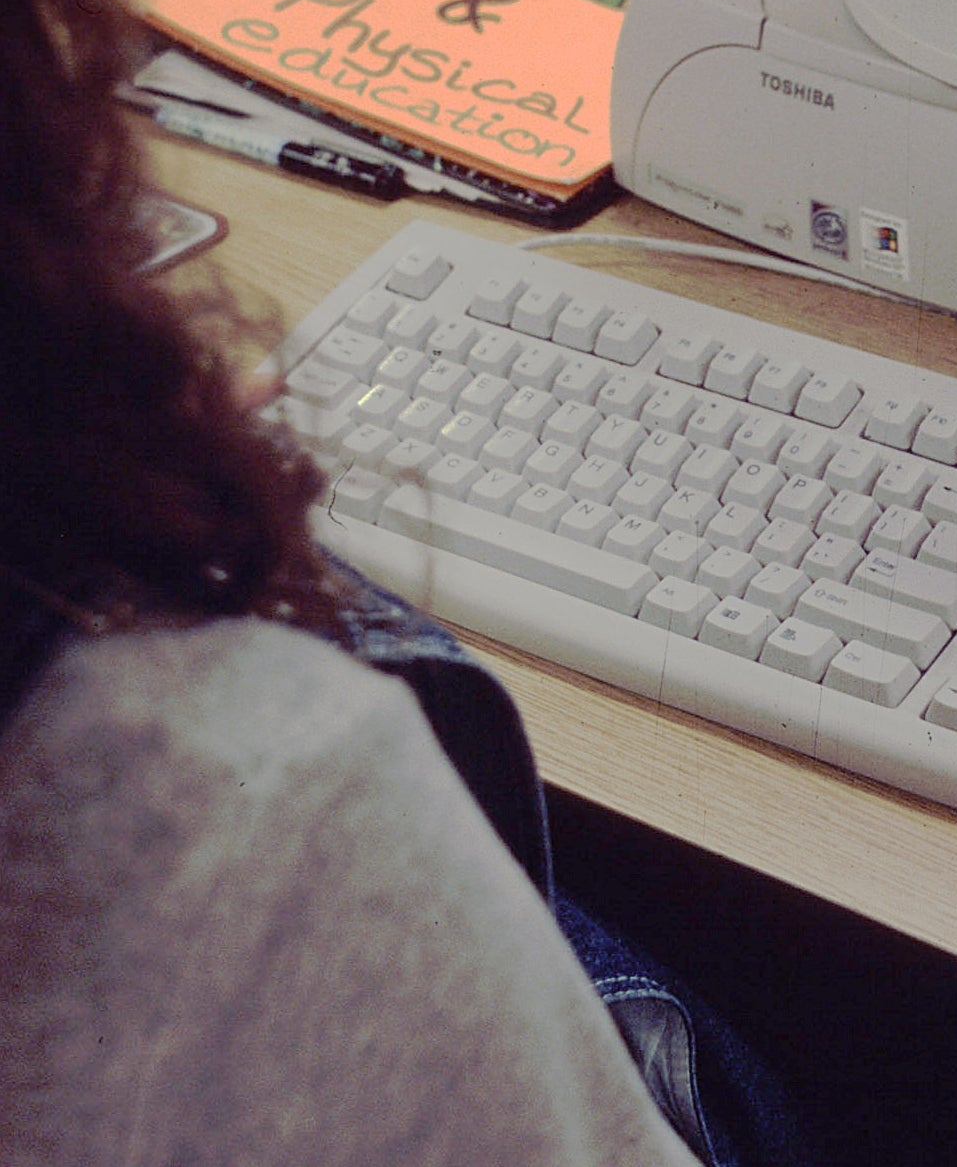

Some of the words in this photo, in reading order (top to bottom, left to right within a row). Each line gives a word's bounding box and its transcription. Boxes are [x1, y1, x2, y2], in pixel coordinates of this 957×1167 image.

[220, 17, 576, 168] education
[760, 71, 836, 111] TOSHIBA
[522, 390, 535, 402] R
[567, 405, 580, 416] T
[612, 419, 624, 431] Y
[653, 433, 668, 446] U
[402, 442, 418, 453] X
[545, 445, 560, 457] G
[447, 457, 460, 469] C
[588, 460, 605, 472] H
[746, 463, 761, 476] O
[634, 478, 649, 488] J
[793, 478, 807, 489] P
[534, 487, 549, 499] B
[679, 490, 695, 503] K
[578, 503, 595, 515] N
[726, 505, 735, 519] L
[624, 518, 642, 531] M
[873, 556, 896, 570] Enter
